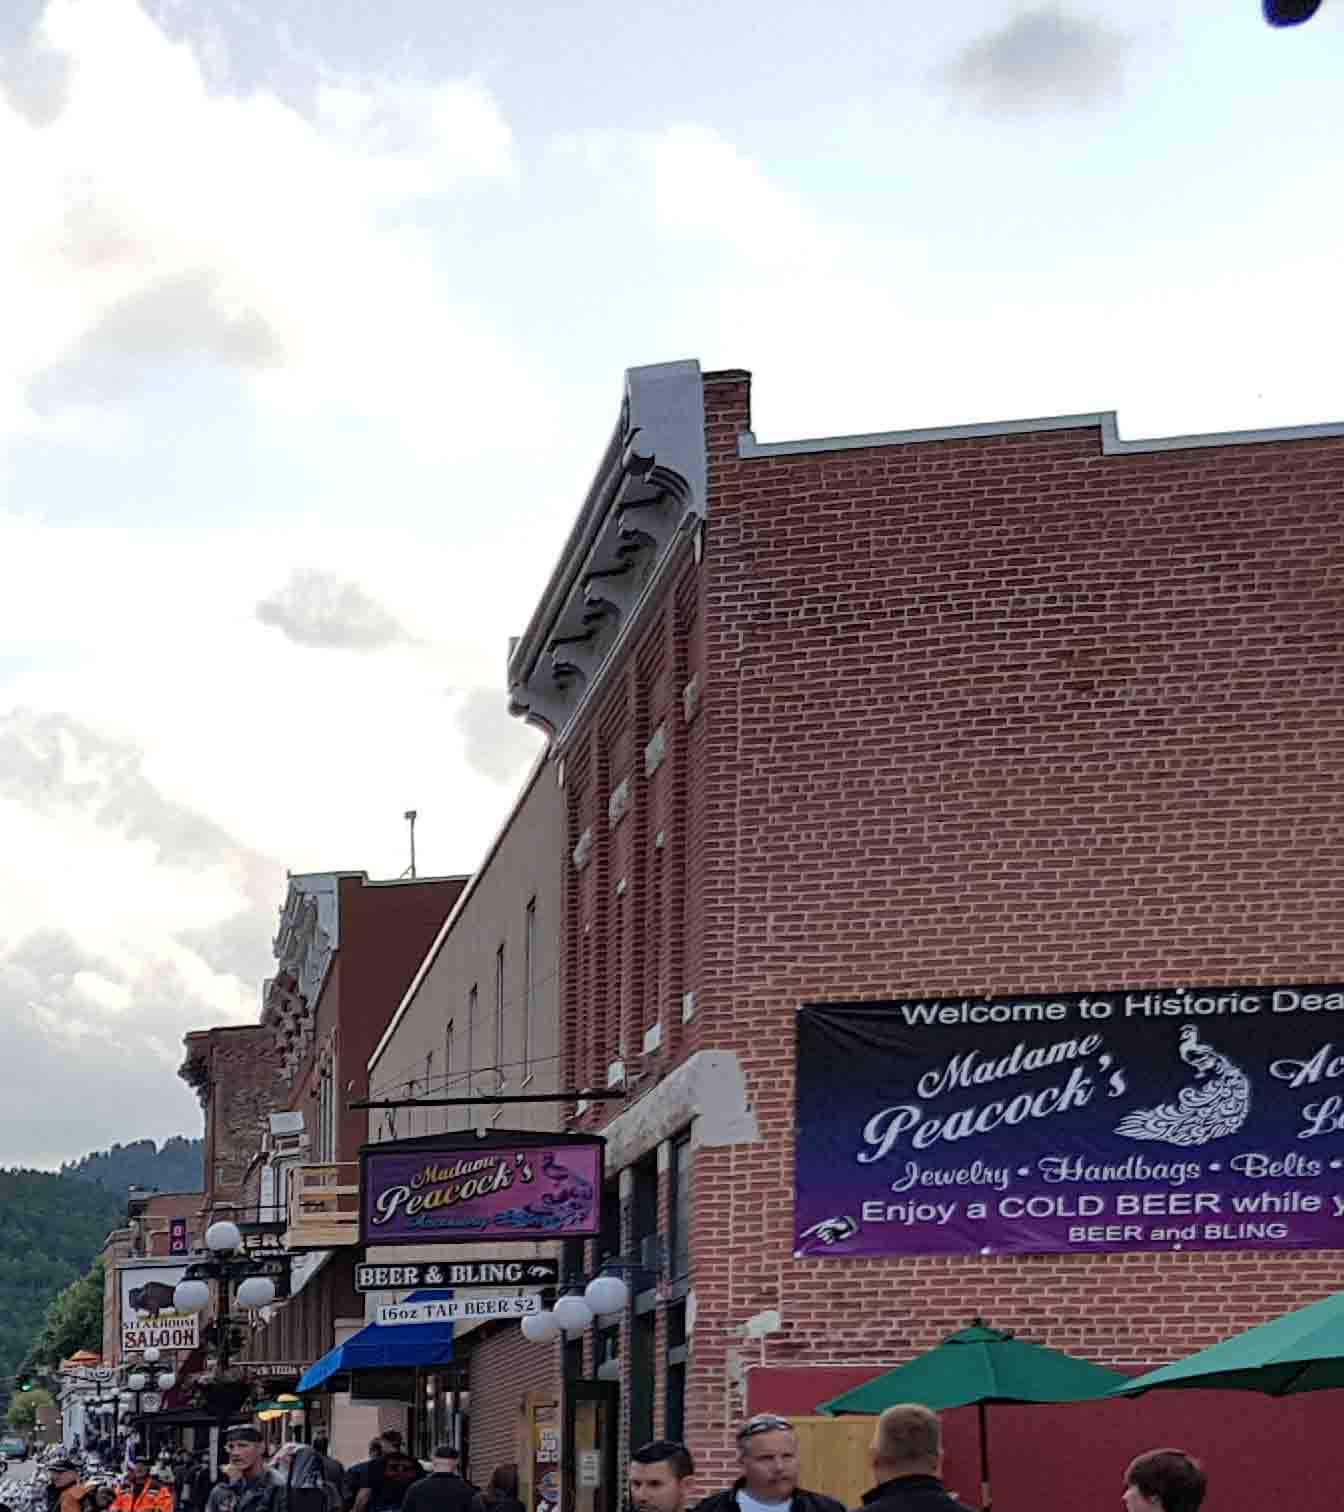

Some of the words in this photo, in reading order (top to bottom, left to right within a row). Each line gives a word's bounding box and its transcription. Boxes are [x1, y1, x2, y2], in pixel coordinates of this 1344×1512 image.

[901, 1000, 1066, 1026] Welcome
[1079, 999, 1111, 1019] to
[1125, 994, 1260, 1017] Historic
[918, 1033, 1105, 1098] Madame
[857, 1054, 1127, 1163] Peacock's
[372, 1152, 536, 1225] Peacock's
[891, 1160, 1009, 1192] Jewelry
[1037, 1154, 1200, 1186] Handbags
[1229, 1152, 1322, 1177] Belts
[861, 1200, 955, 1225] Enjoy
[966, 1202, 987, 1219] a
[999, 1196, 1105, 1219] COLD
[1116, 1192, 1222, 1216] BEER
[1231, 1191, 1322, 1214] while
[1069, 1225, 1144, 1242] BEER
[1150, 1224, 1196, 1240] and
[1204, 1222, 1289, 1239] BLING
[358, 1265, 419, 1287] BEER
[424, 1264, 444, 1284] &
[448, 1262, 524, 1284] BLING
[381, 1306, 418, 1322] 16oz
[424, 1301, 458, 1319] TAP
[464, 1299, 510, 1315] BEER
[512, 1297, 537, 1313] $2
[124, 1328, 194, 1348] SALOON
